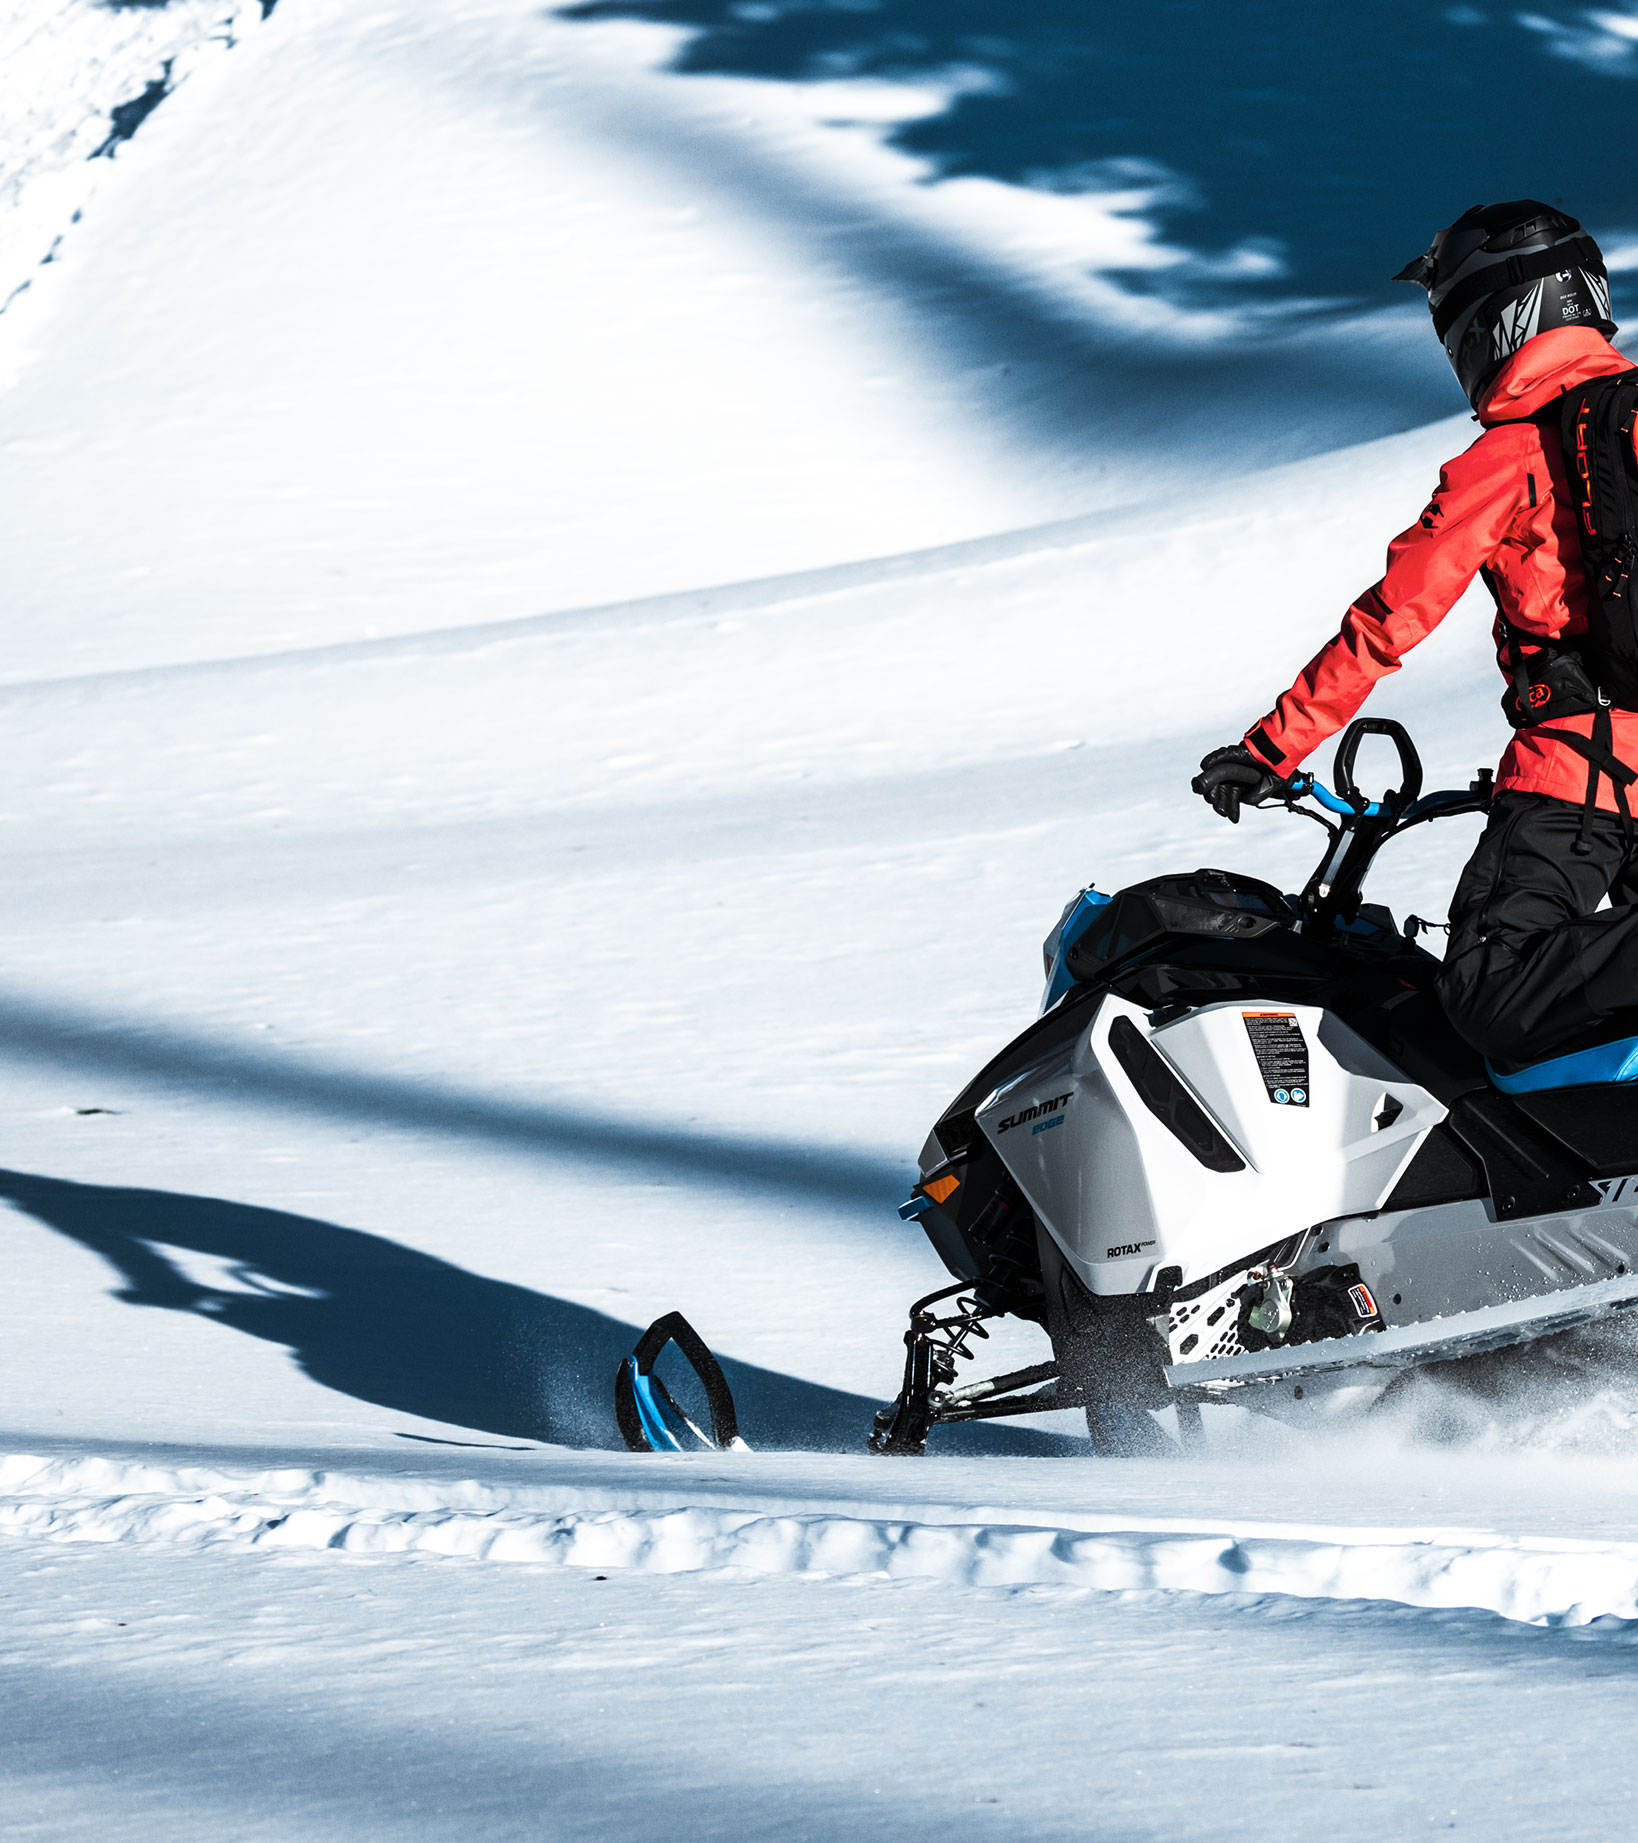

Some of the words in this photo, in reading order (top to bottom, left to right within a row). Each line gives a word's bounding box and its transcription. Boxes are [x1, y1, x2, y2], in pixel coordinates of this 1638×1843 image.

[1562, 304, 1579, 315] DOT
[1576, 397, 1598, 536] FLOAT
[997, 1091, 1074, 1134] SUMMIT
[1032, 1114, 1065, 1135] EDGE
[1107, 1242, 1142, 1259] ROTAX
